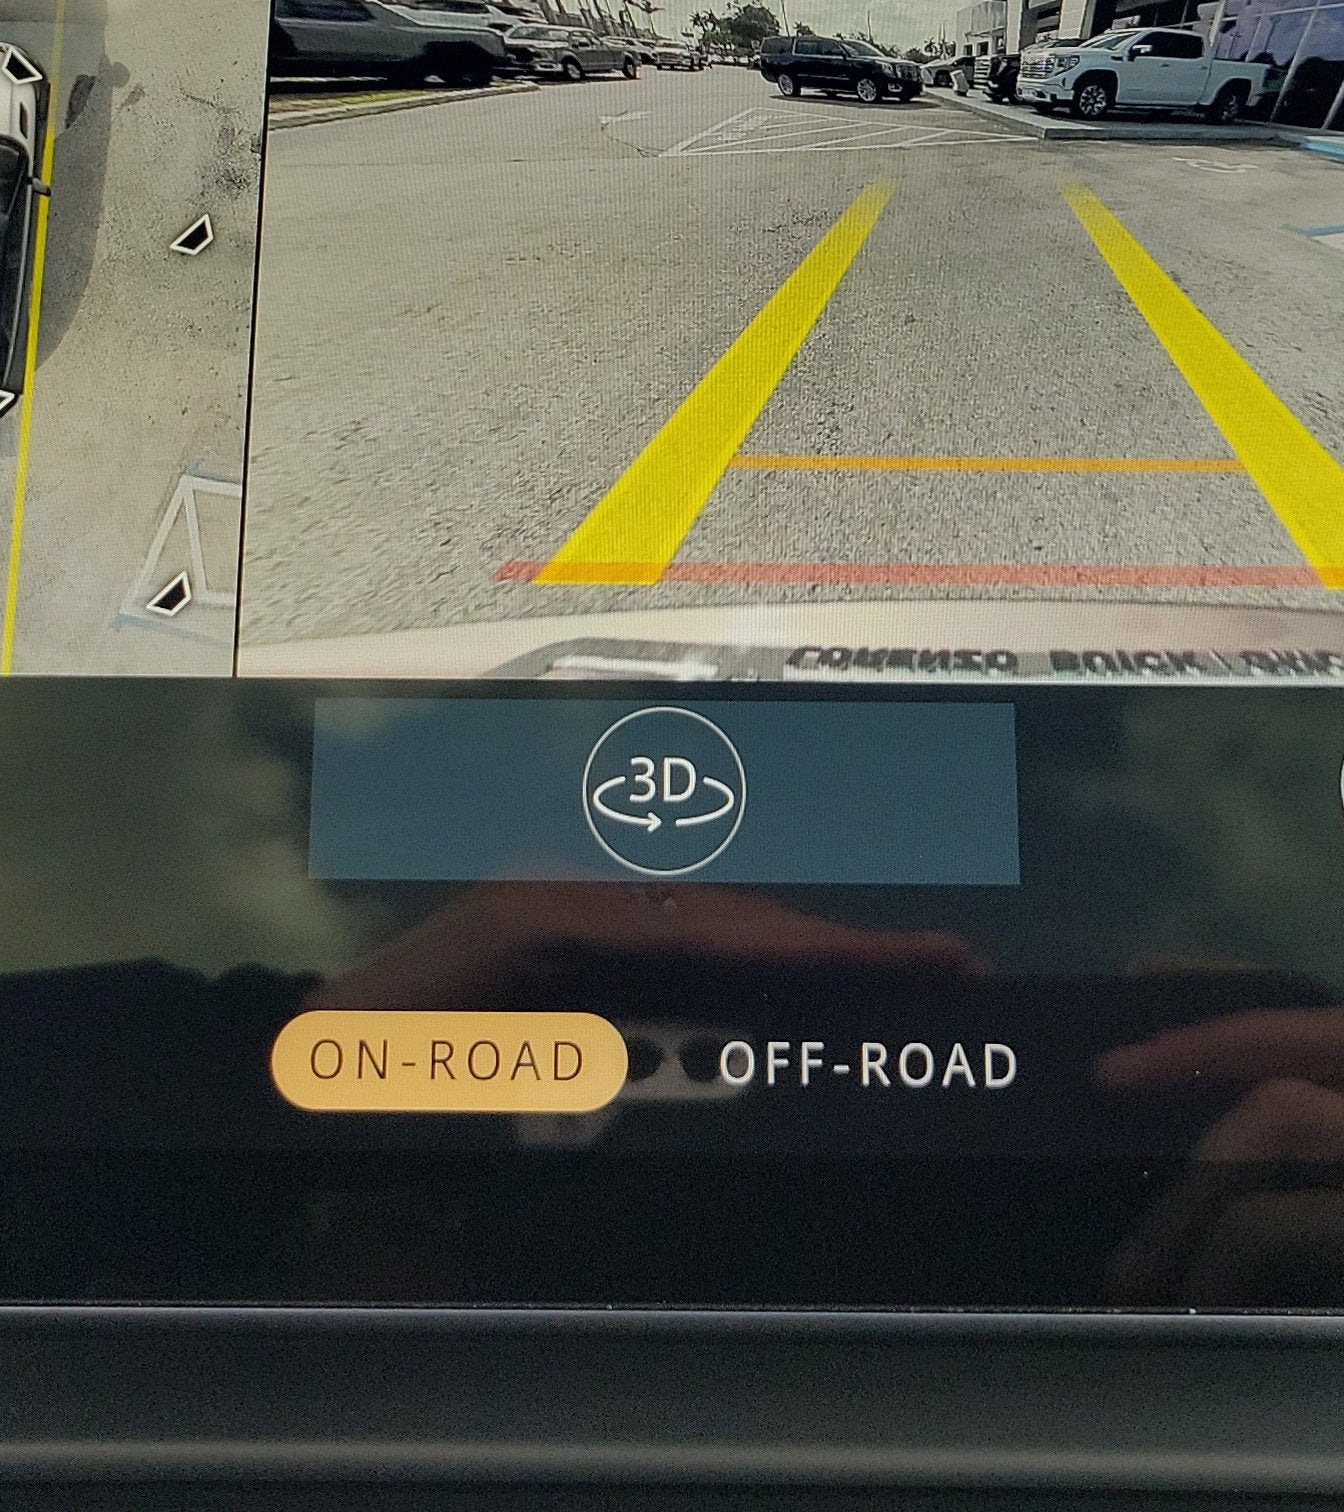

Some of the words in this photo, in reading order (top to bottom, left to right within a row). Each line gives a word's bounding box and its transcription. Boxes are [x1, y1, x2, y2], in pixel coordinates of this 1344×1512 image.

[628, 757, 697, 803] 3D
[310, 1038, 584, 1081] ON-ROAD
[719, 1040, 1017, 1088] OFF-ROAD
